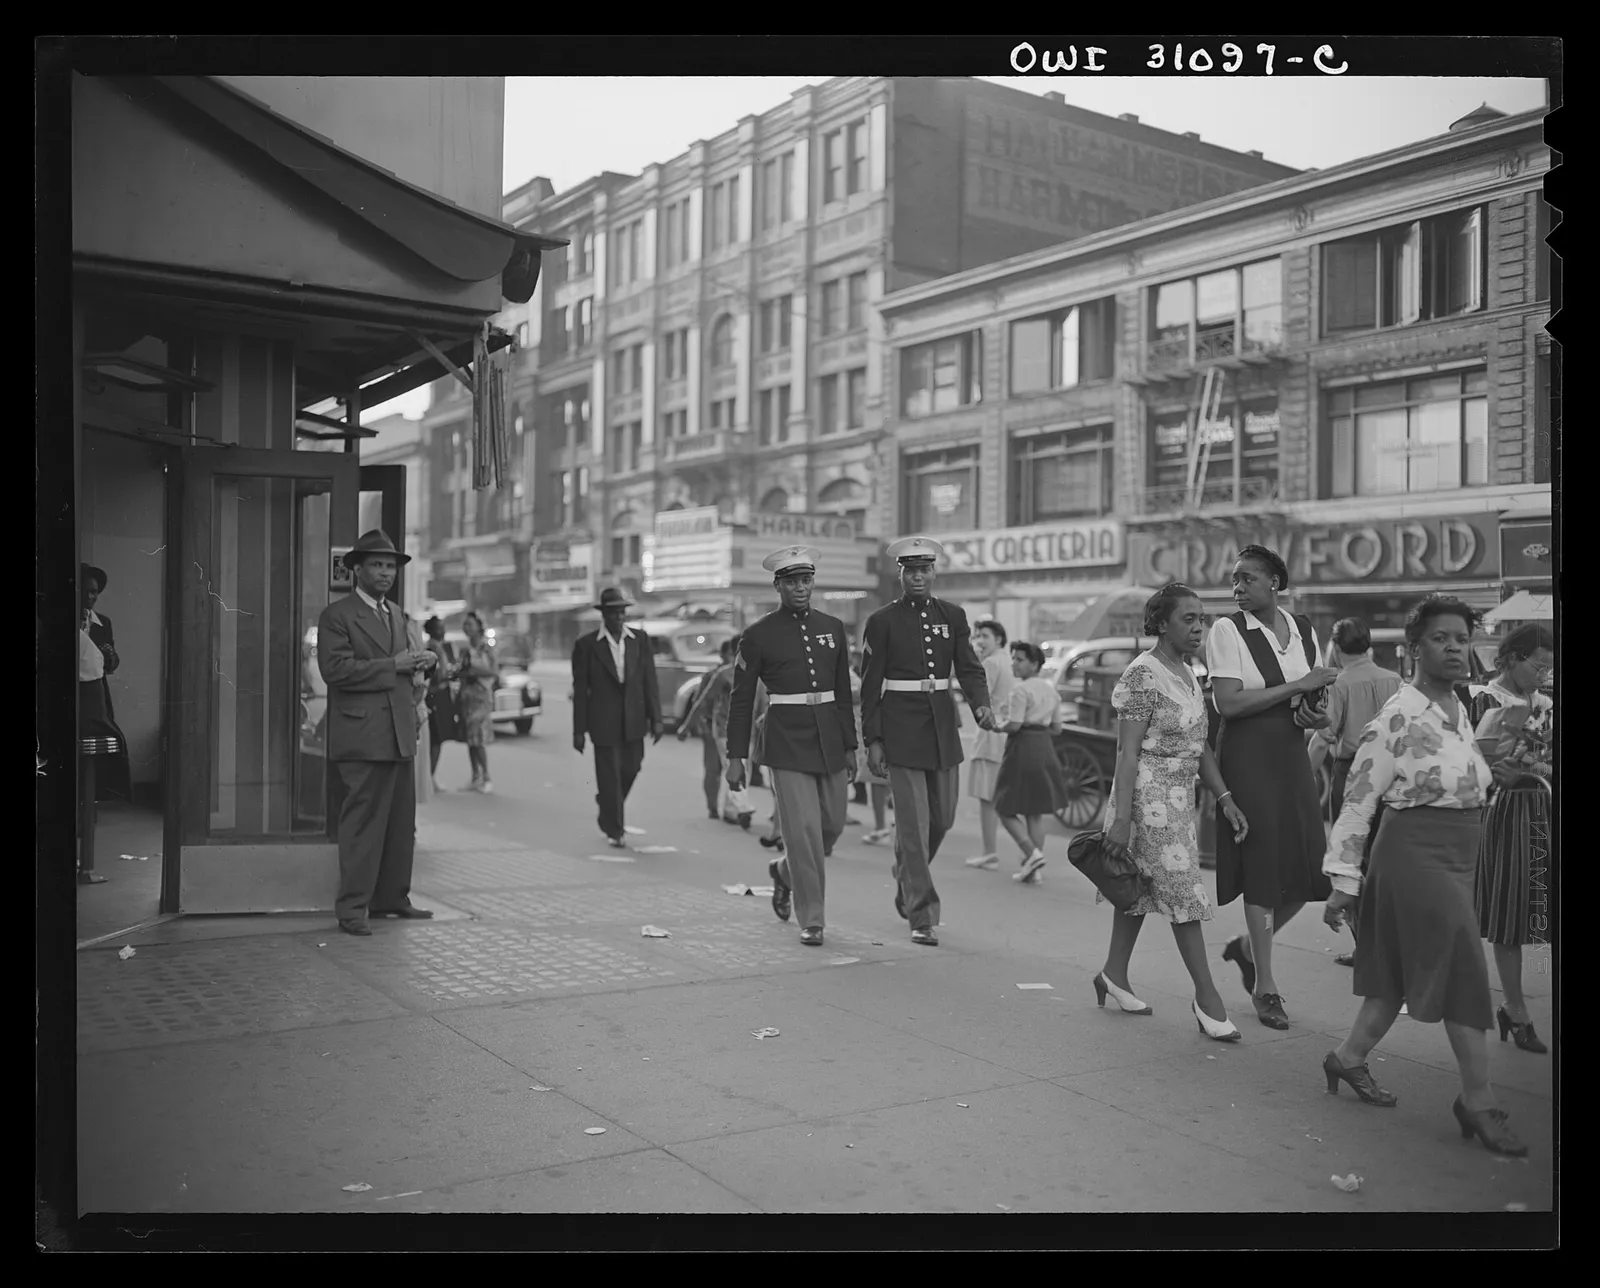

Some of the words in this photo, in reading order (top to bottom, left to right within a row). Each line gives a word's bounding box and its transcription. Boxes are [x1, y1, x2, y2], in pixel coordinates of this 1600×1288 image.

[1010, 41, 1107, 73] OWI
[1146, 42, 1349, 75] 31097-C
[992, 529, 1114, 564] CAFETERIA
